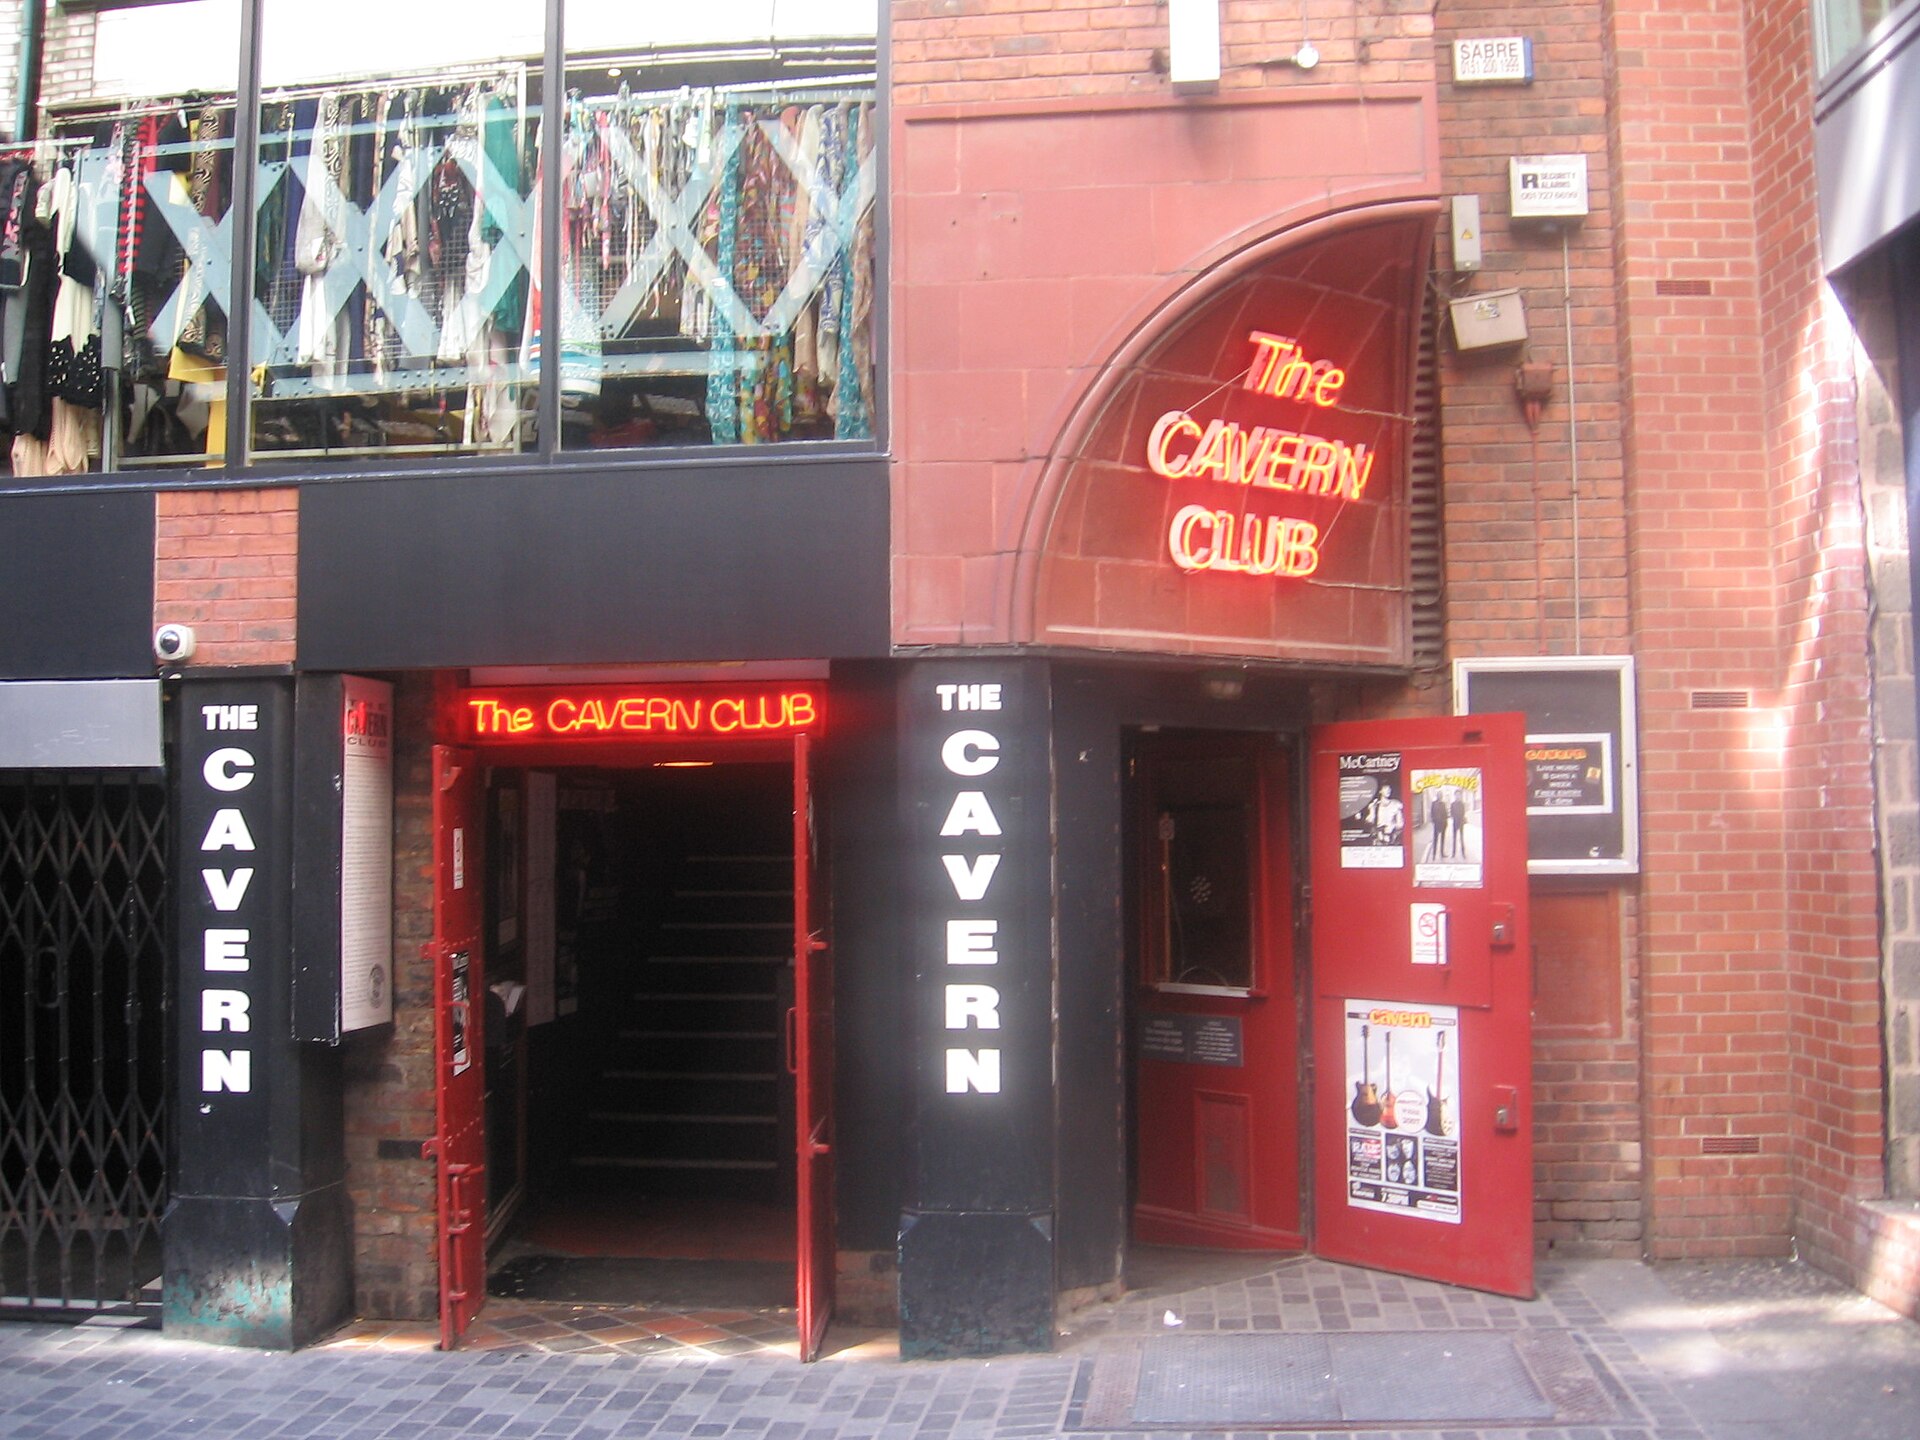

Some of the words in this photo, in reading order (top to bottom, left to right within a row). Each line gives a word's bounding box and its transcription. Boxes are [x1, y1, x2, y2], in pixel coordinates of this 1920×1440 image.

[1460, 42, 1518, 60] SABRE
[1521, 173, 1539, 189] R
[1540, 171, 1576, 180] SECURITY
[1540, 181, 1571, 189] ALARMS
[1243, 331, 1345, 407] The
[1147, 410, 1375, 500] CAVERN
[1169, 503, 1319, 578] CLUB
[936, 684, 1002, 711] THE
[201, 705, 259, 730] THE
[468, 699, 535, 733] The
[547, 697, 702, 733] CAVERN
[709, 692, 816, 732] CLUB
[347, 736, 387, 749] CLUB
[1340, 755, 1401, 770] McCartney
[201, 747, 257, 1093] CAVERN
[939, 729, 1002, 1093] CAVERN
[1369, 1009, 1431, 1028] cavern
